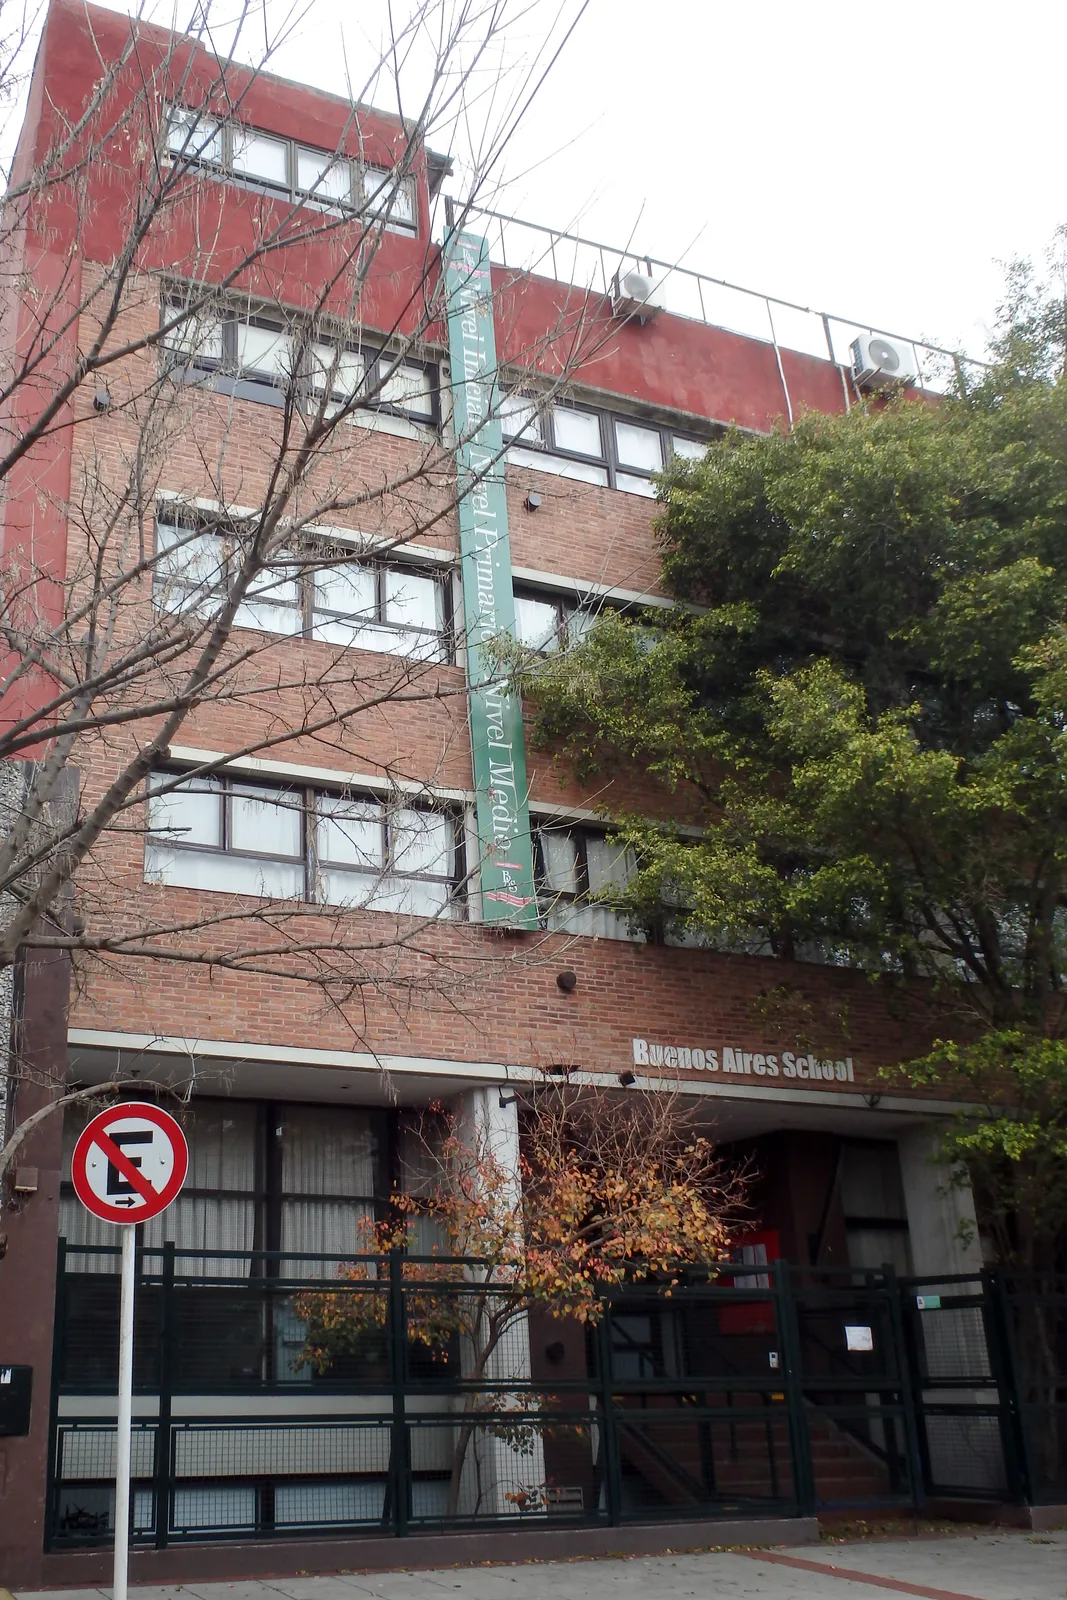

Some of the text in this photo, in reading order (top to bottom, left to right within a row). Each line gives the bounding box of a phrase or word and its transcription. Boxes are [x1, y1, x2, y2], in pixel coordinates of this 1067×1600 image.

[459, 277, 486, 341] Nivel
[463, 346, 490, 429] Inicial
[470, 449, 496, 517] Nivel
[476, 524, 506, 642] Primario
[484, 674, 512, 749] Nivel
[488, 758, 519, 851] Medio
[632, 1038, 855, 1082] Buenos Aires School
[107, 1131, 154, 1195] E
